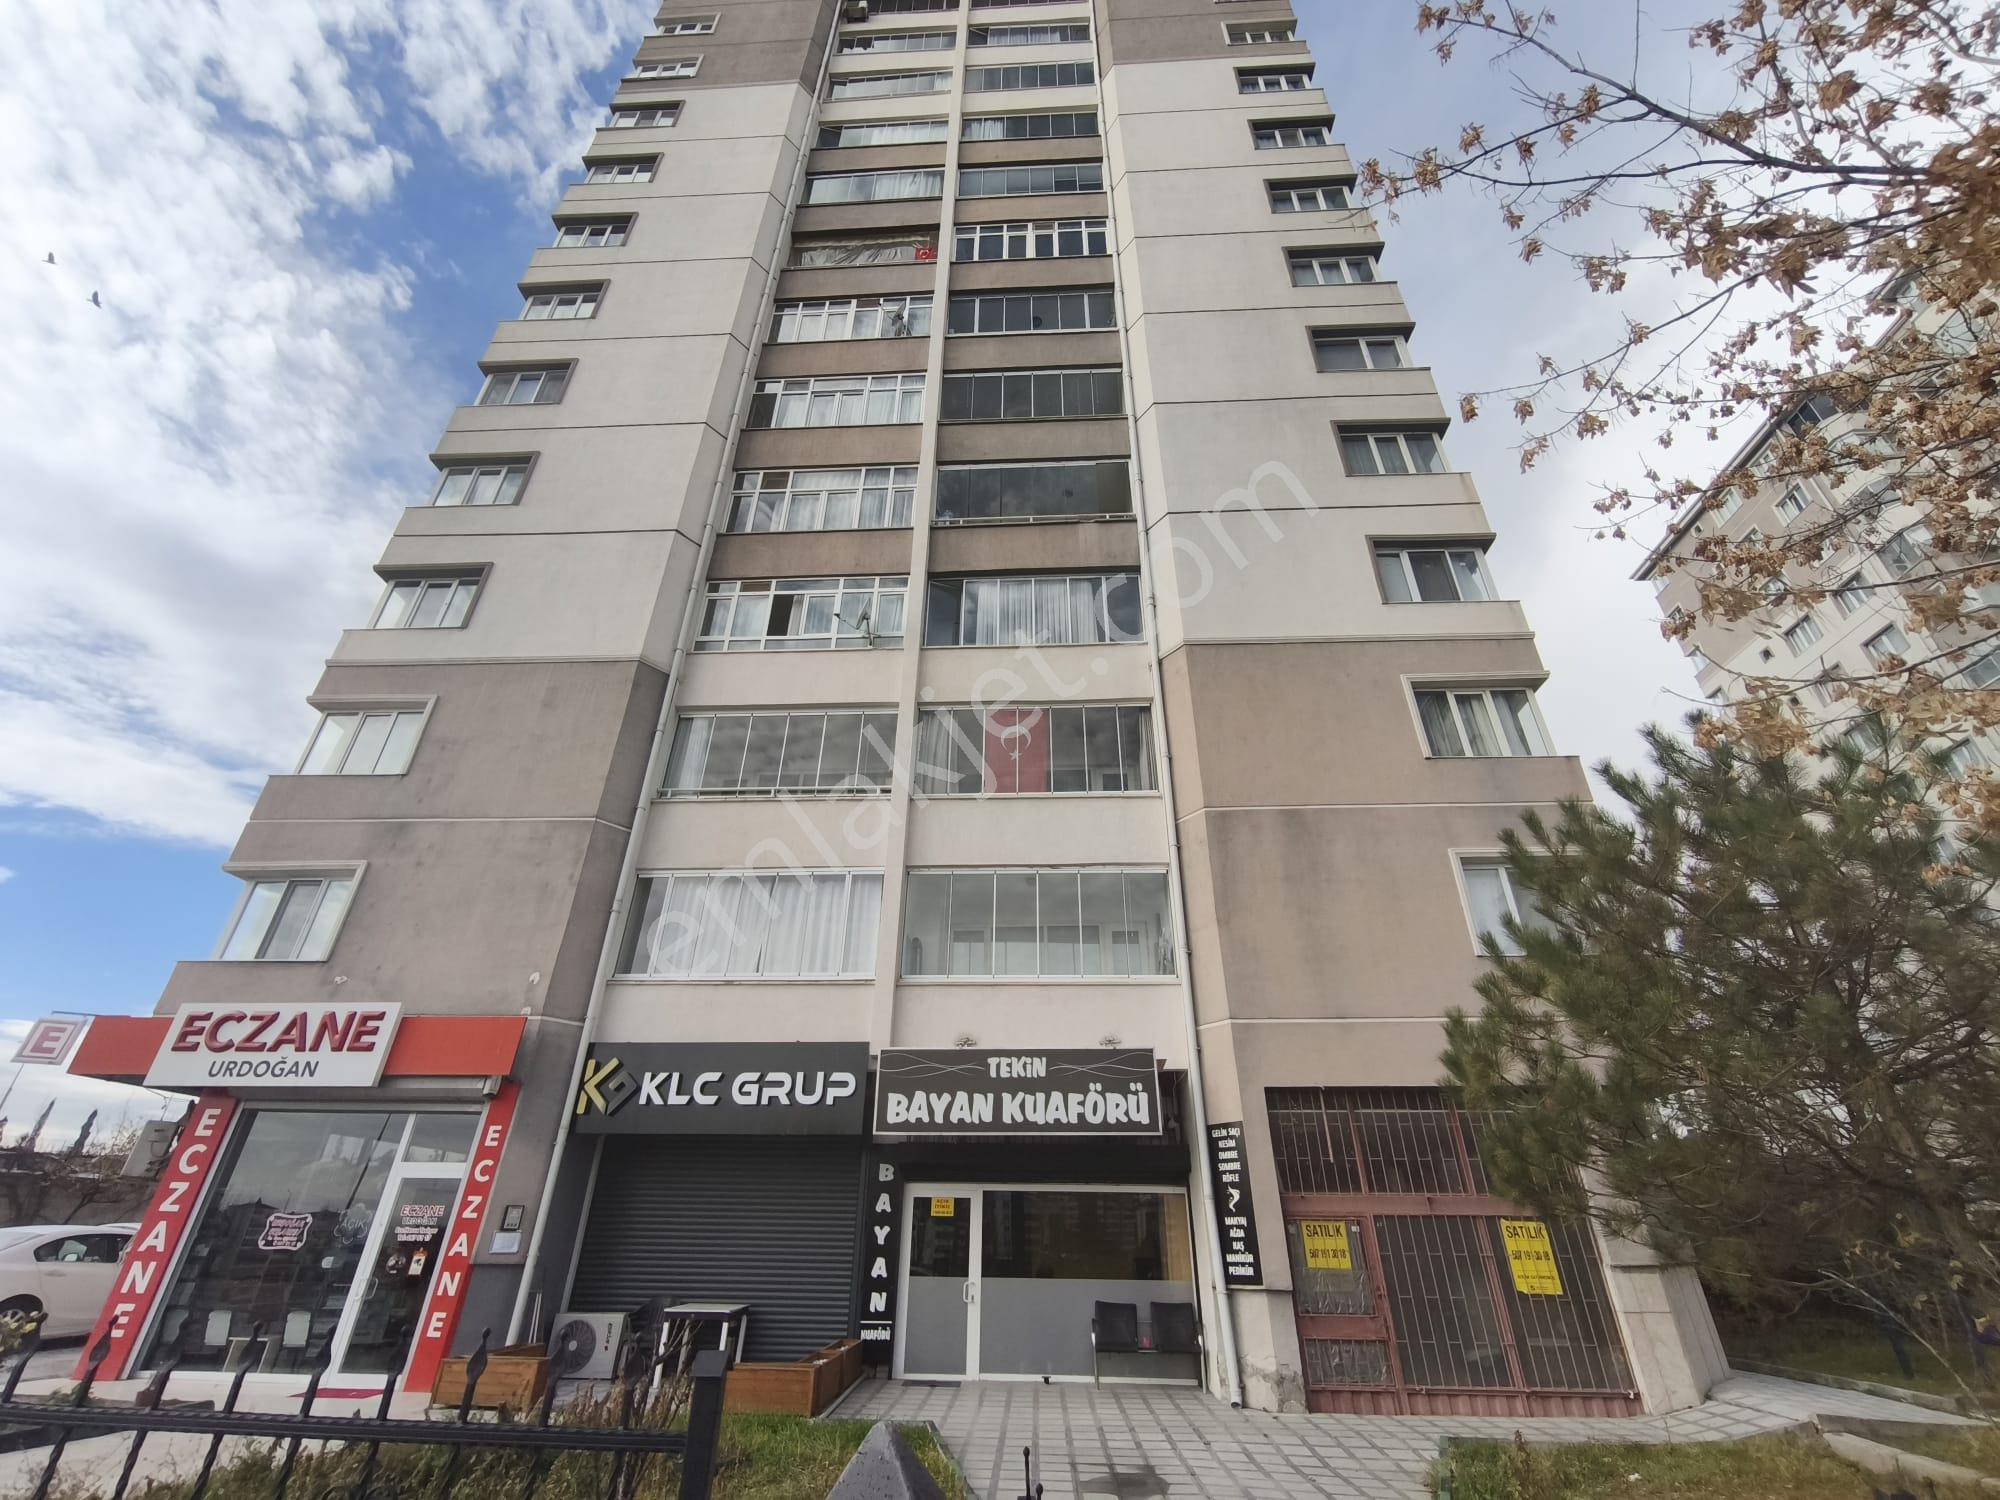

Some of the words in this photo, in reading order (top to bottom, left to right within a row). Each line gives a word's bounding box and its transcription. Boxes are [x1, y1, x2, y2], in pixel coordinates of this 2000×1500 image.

[29, 1026, 65, 1054] E
[170, 1010, 387, 1053] ECZANE
[207, 1056, 320, 1079] URDOĞAN
[638, 1071, 723, 1106] KLC
[731, 1071, 857, 1106] GRUP
[886, 1090, 995, 1125] BAYAN
[1001, 1082, 1150, 1125] KUAFÖRÜ
[110, 1108, 222, 1338] ECZANE
[400, 1205, 446, 1217] ECZANE
[426, 1125, 502, 1338] ECZANE
[869, 1163, 895, 1313] BAYAN
[1305, 1224, 1344, 1238] SATILIK
[1505, 1225, 1544, 1239] SATILIK
[860, 1326, 891, 1341] KUAFÖRÜ
